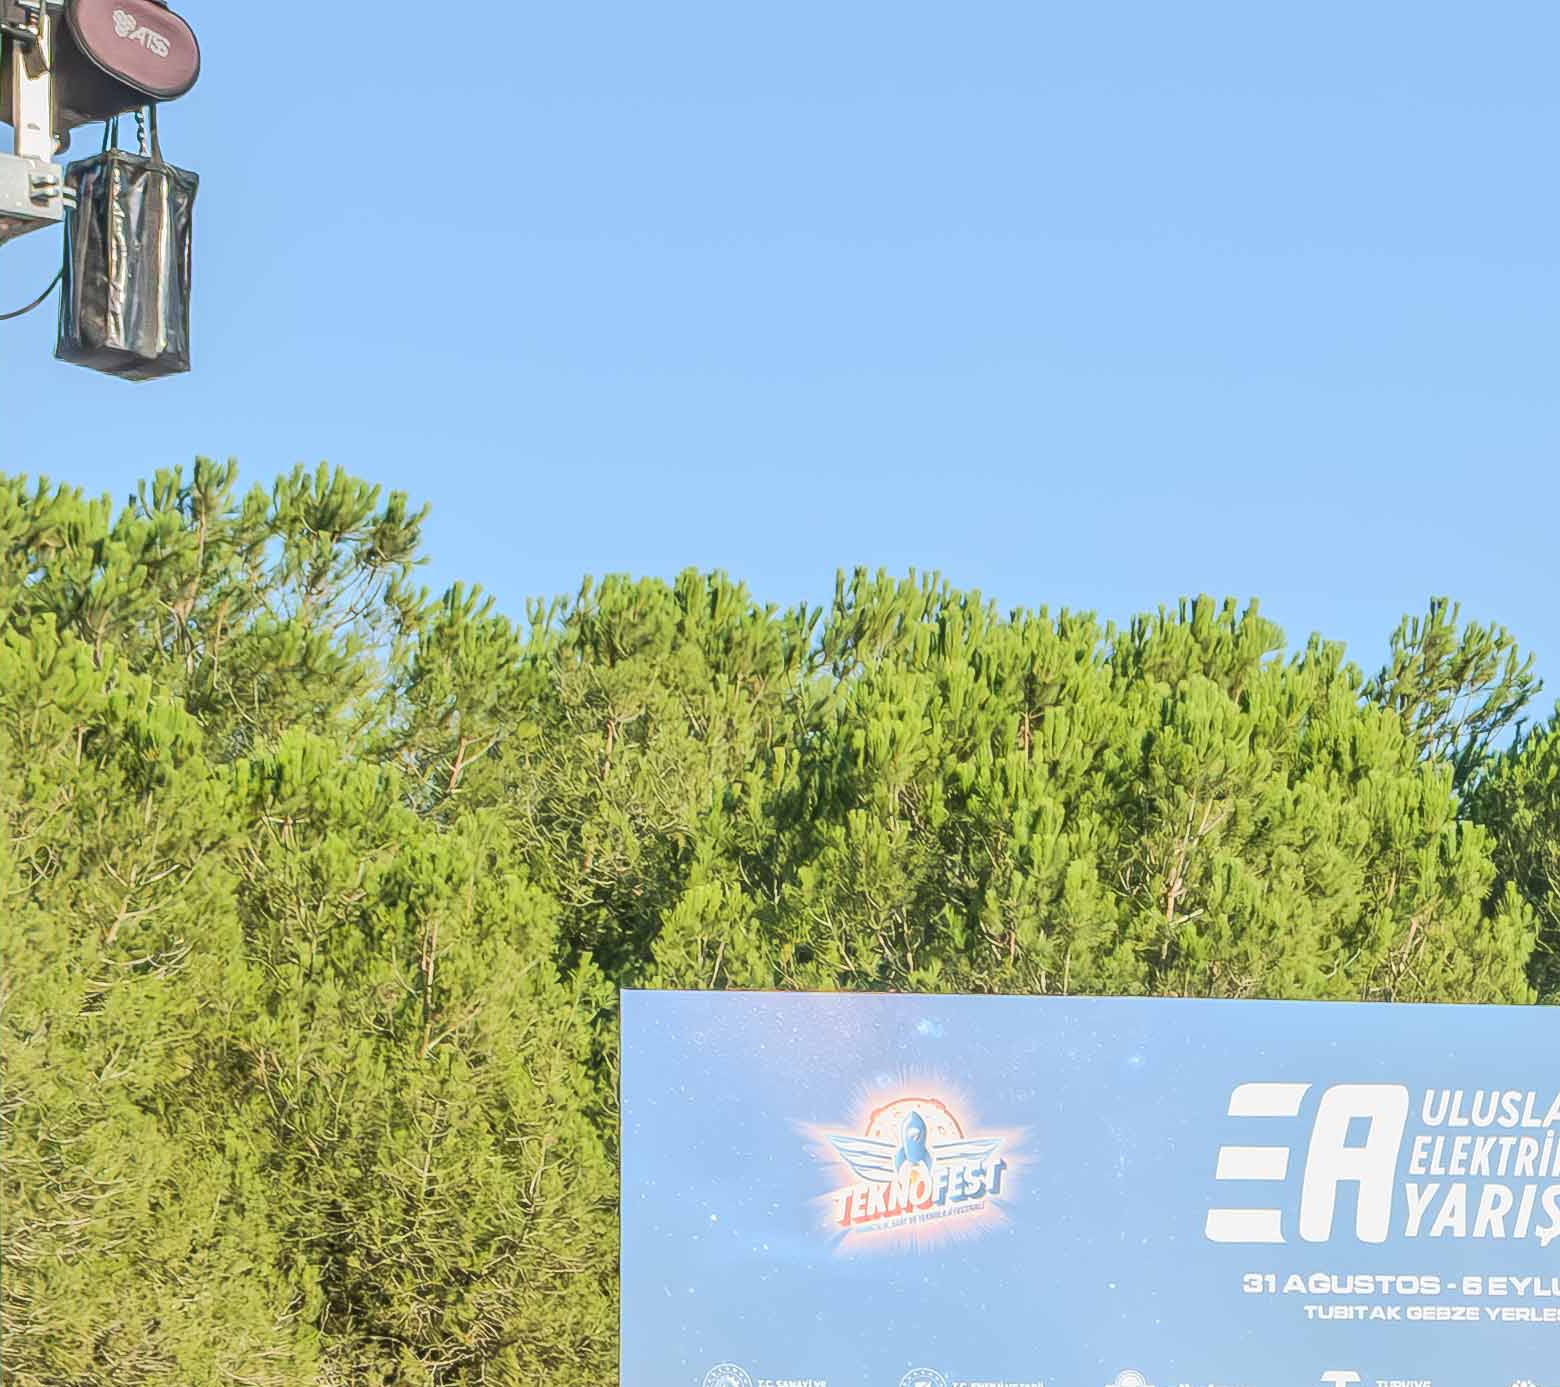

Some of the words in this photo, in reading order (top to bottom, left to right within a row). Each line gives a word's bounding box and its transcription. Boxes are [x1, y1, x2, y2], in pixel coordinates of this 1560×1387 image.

[837, 1157, 1007, 1227] TEKNOFEST
[1242, 1273, 1276, 1294] 31
[1283, 1272, 1441, 1295] AĞUSTOS
[1462, 1276, 1482, 1296] 6
[1406, 1305, 1480, 1321] GEBZE
